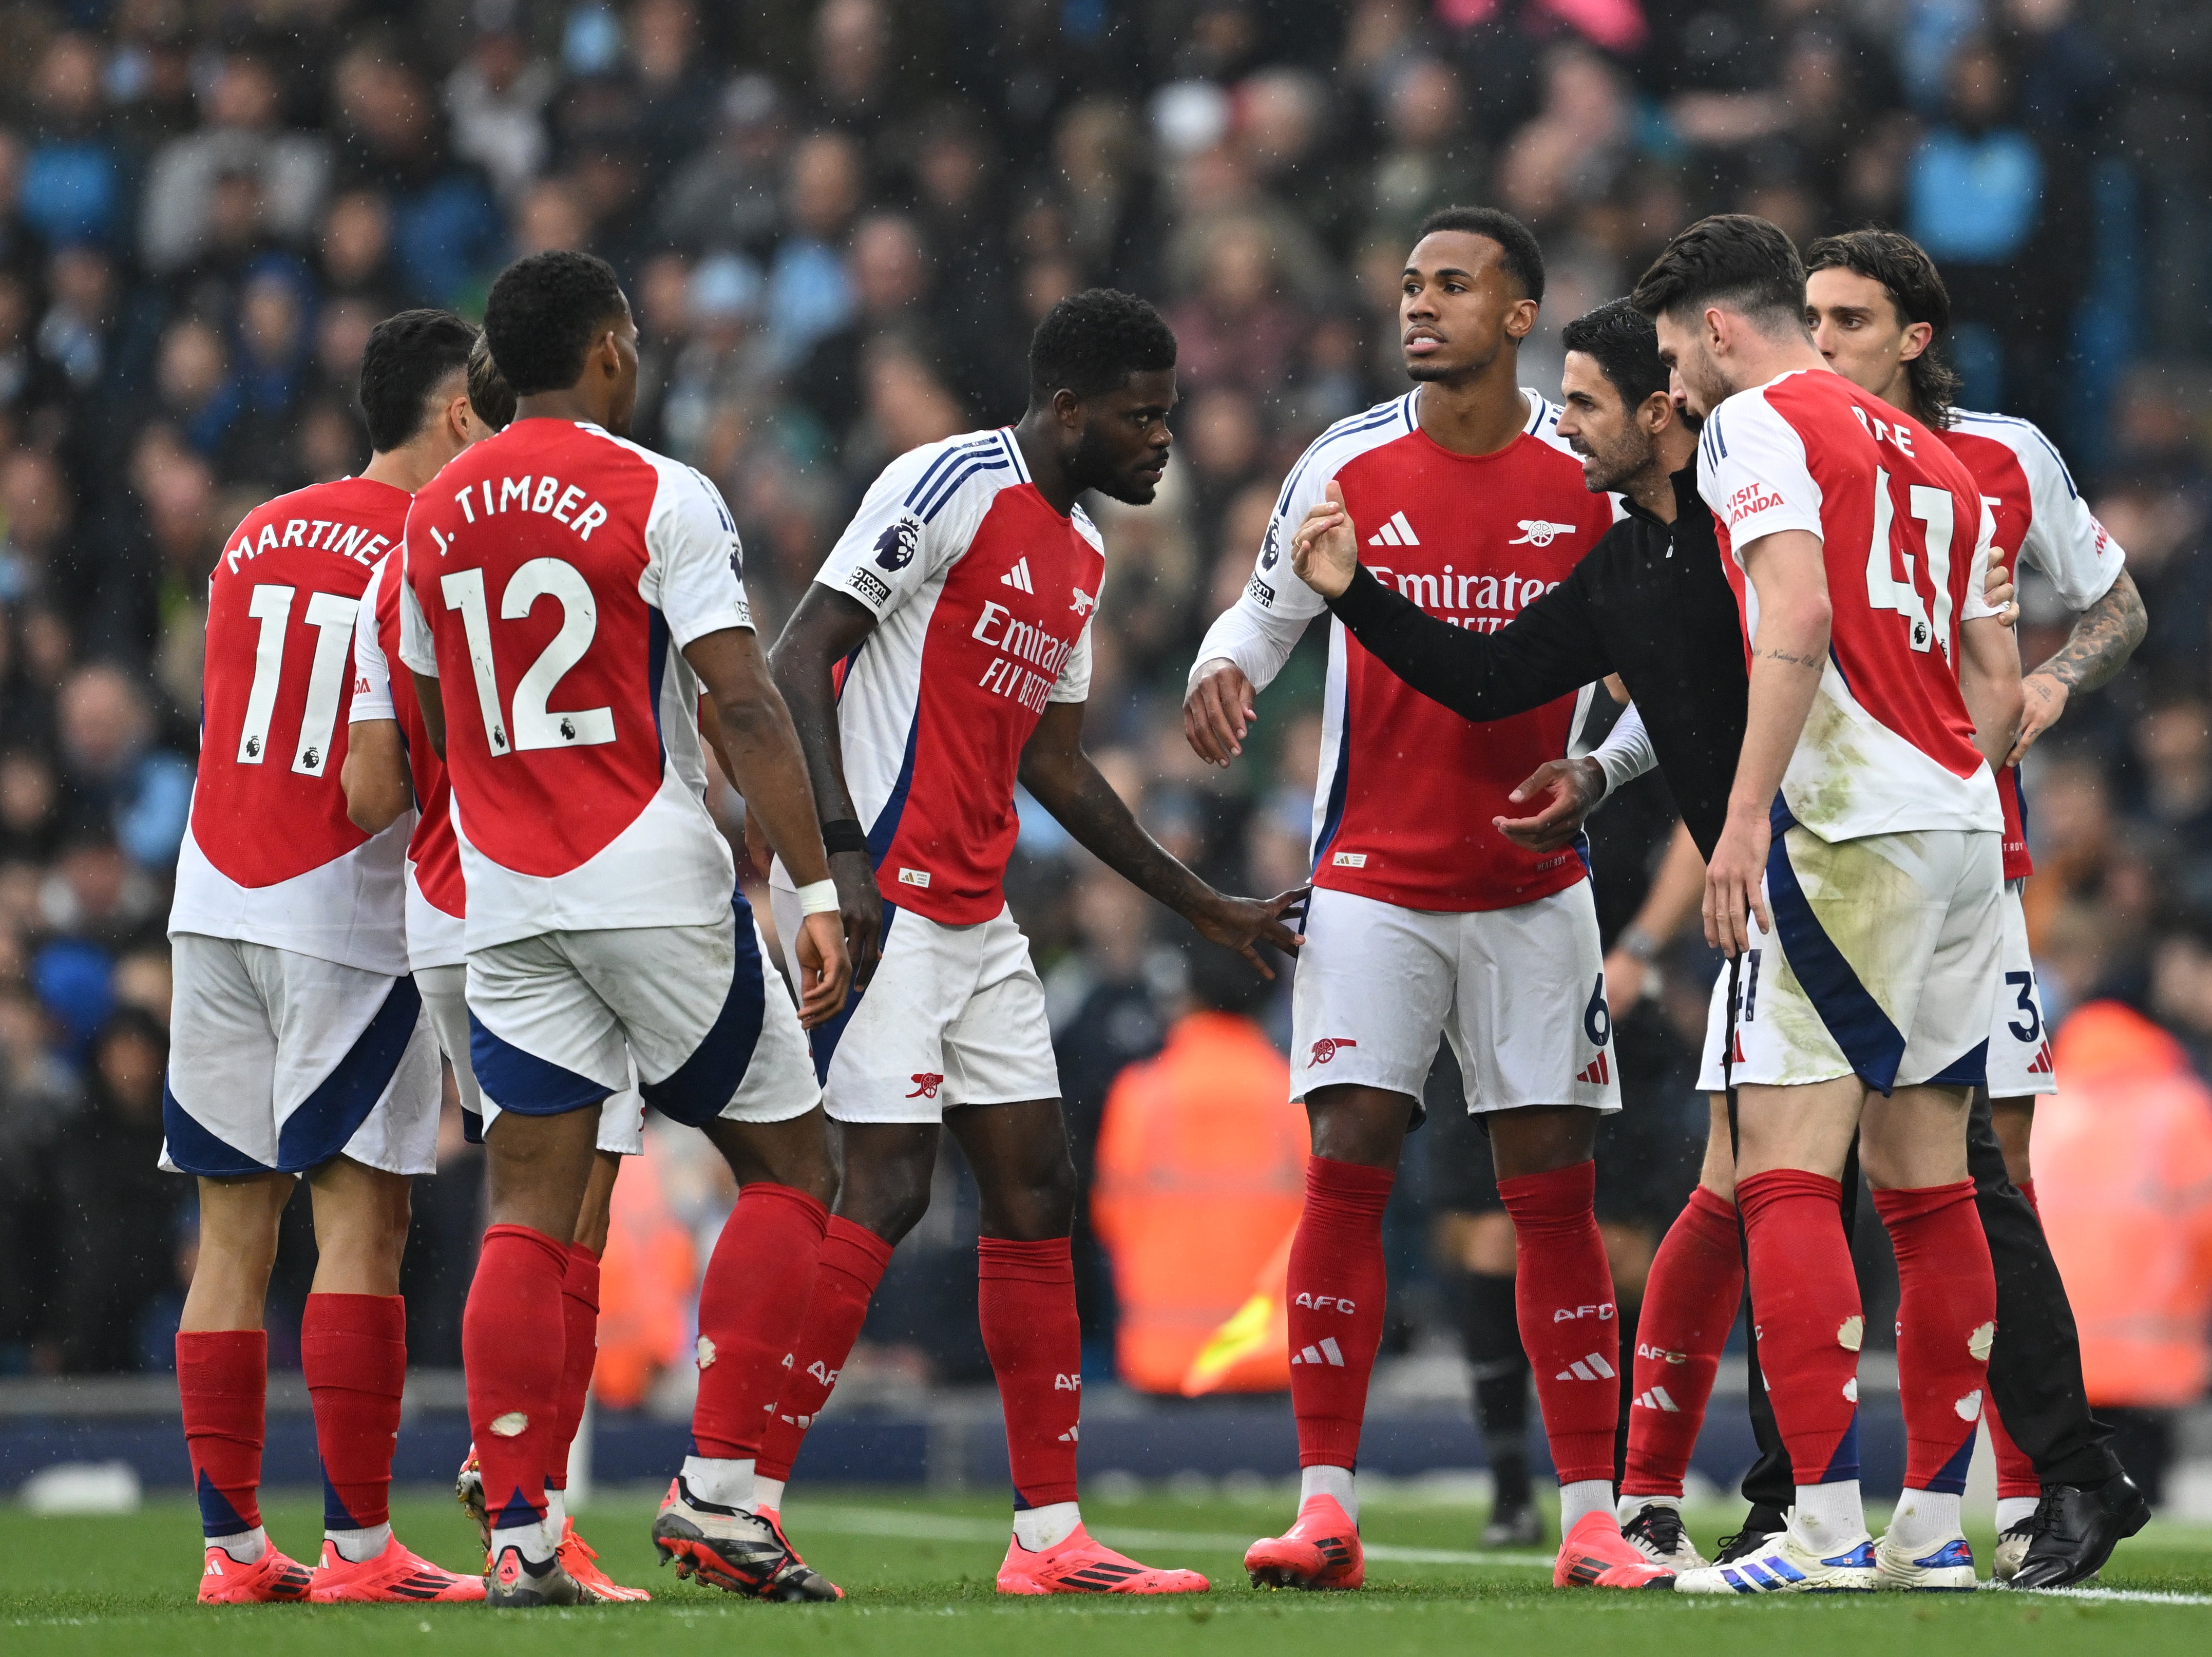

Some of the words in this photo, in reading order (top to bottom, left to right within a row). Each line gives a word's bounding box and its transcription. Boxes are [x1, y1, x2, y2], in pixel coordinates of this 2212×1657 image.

[430, 525, 455, 557] J.
[455, 475, 607, 542] TIMBER
[1726, 483, 1760, 512] VISIT
[1729, 492, 1784, 531] ANDA
[226, 519, 390, 575] MARTINE
[863, 573, 887, 598] room
[1865, 464, 1955, 671] 41
[846, 576, 859, 586] or
[856, 581, 884, 608] racism
[440, 556, 617, 758] 12
[971, 600, 1073, 677] Emirate
[236, 583, 361, 778] 11
[978, 657, 1023, 698] FLY
[1536, 854, 1565, 872] HEAT.RDY
[1584, 972, 1611, 1046] 6
[2005, 970, 2046, 1043] 3
[1295, 1292, 1356, 1315] AFC
[1553, 1303, 1614, 1323] AFC
[1637, 1342, 1687, 1364] AFC
[806, 1360, 841, 1387] AF
[1054, 1373, 1082, 1391] AF
